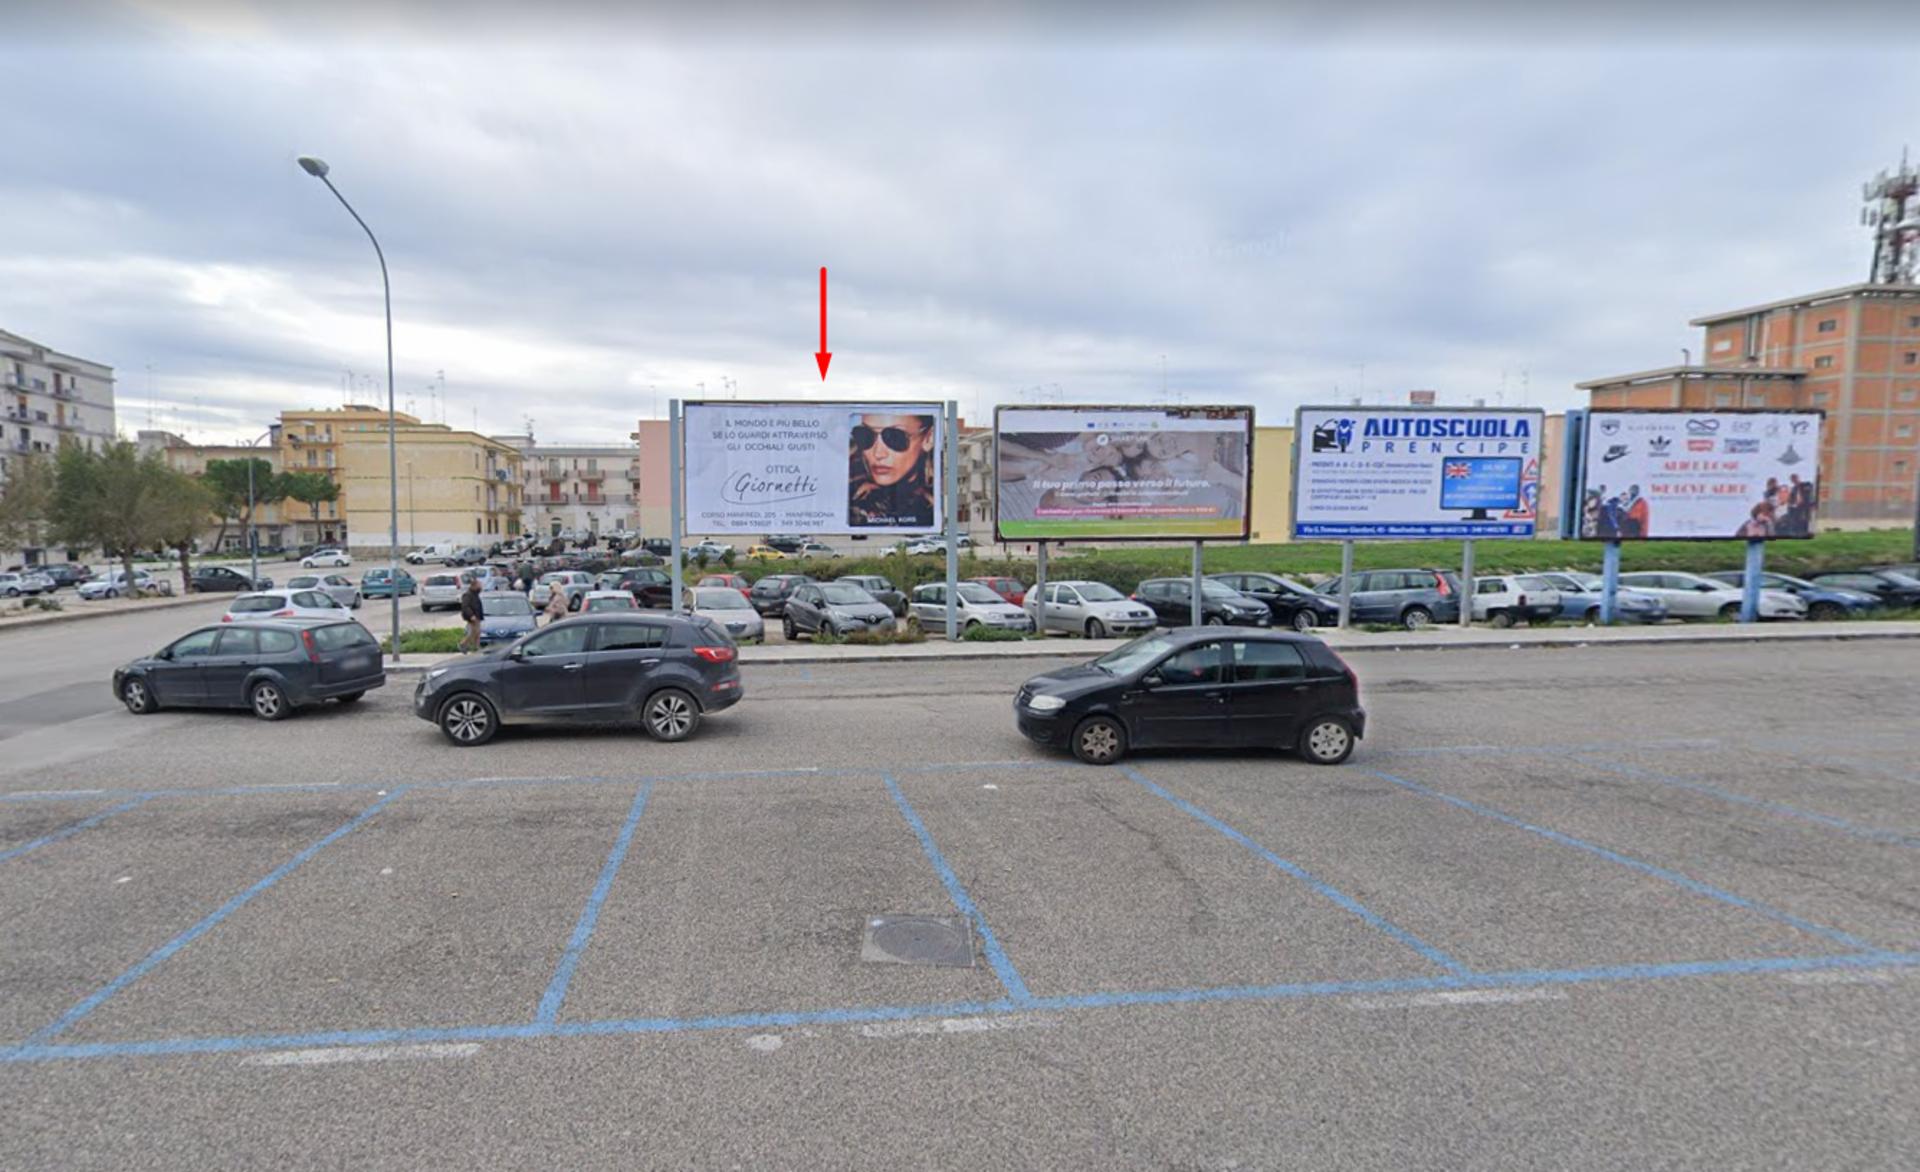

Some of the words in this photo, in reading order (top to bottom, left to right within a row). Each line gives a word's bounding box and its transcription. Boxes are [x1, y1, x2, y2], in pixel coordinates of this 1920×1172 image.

[734, 419, 768, 428] MONDO
[792, 419, 820, 428] BELLO
[1363, 418, 1531, 438] AUTOSCUOLA
[738, 431, 770, 440] GUARDI
[772, 431, 828, 440] ATTRAVERSO
[727, 443, 741, 451] GLI
[745, 443, 784, 451] OCCHIALI
[787, 443, 815, 451] GIUSTI
[1361, 441, 1529, 454] PRENCIPE
[766, 464, 801, 474] OTTICA
[734, 472, 818, 501] Giornetti
[1042, 480, 1061, 489] tuo
[1061, 480, 1096, 491] primo
[1097, 480, 1131, 491] passo
[1132, 480, 1164, 489] verso
